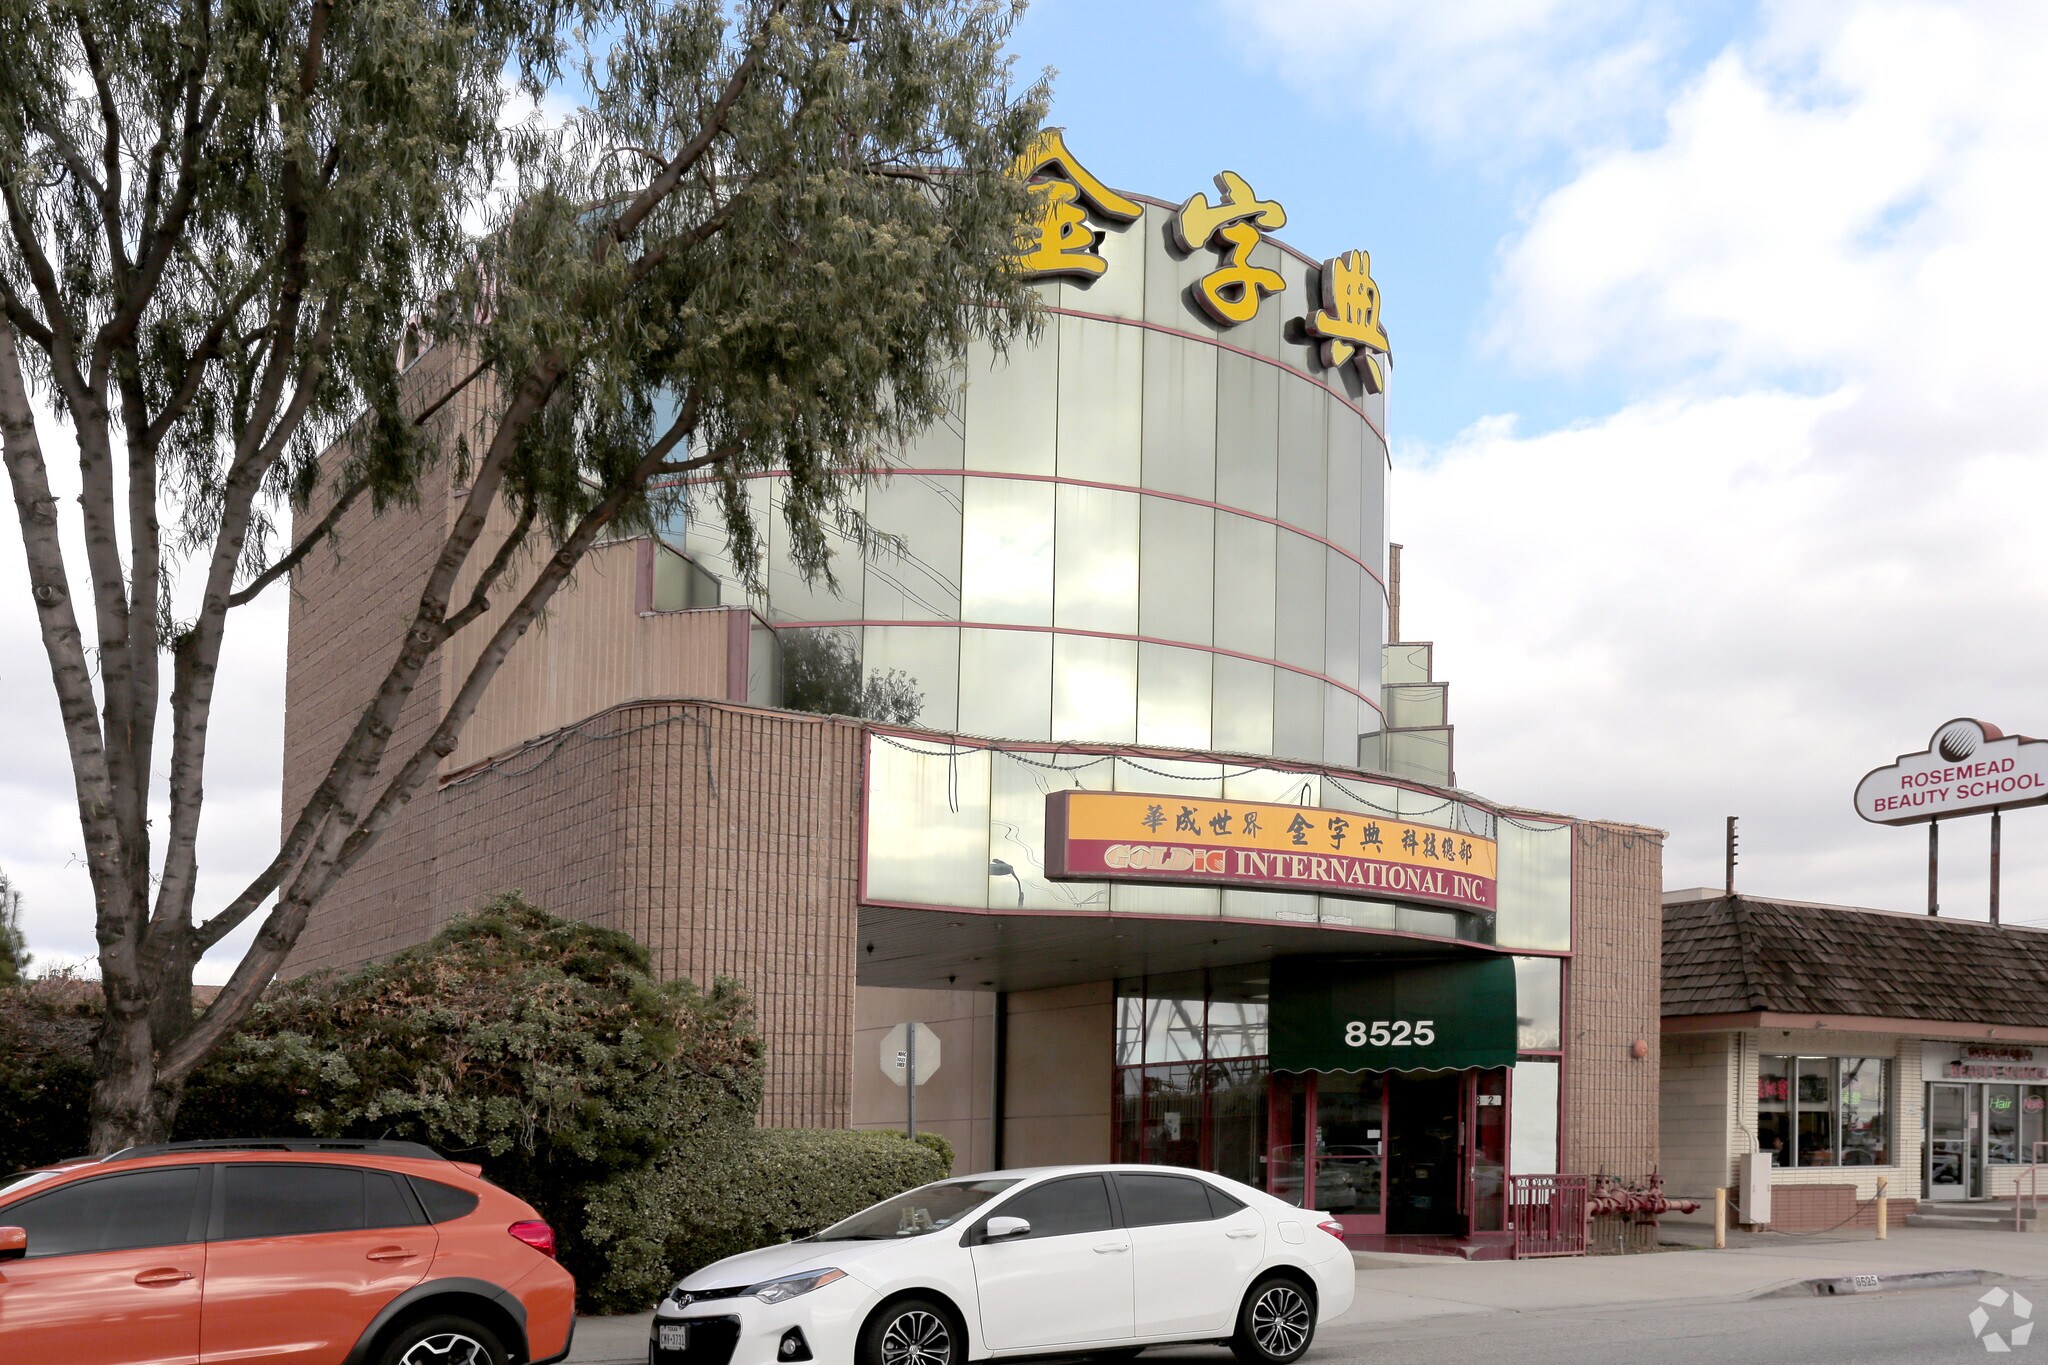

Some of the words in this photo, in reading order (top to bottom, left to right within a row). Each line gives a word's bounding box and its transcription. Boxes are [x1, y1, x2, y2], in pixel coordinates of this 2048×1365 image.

[1000, 127, 1390, 394] 金字典
[1901, 758, 2015, 789] ROSEMEAD
[1874, 788, 1949, 812] BEAUTY
[1957, 773, 2045, 799] SCHOOL
[1141, 804, 1263, 838] 華成世界
[1235, 850, 1448, 896] INTERNATIONAL
[1453, 874, 1486, 902] INC.
[1344, 1020, 1435, 1047] 8525
[1990, 1098, 2012, 1109] Hair
[1855, 1276, 1877, 1287] 8525
